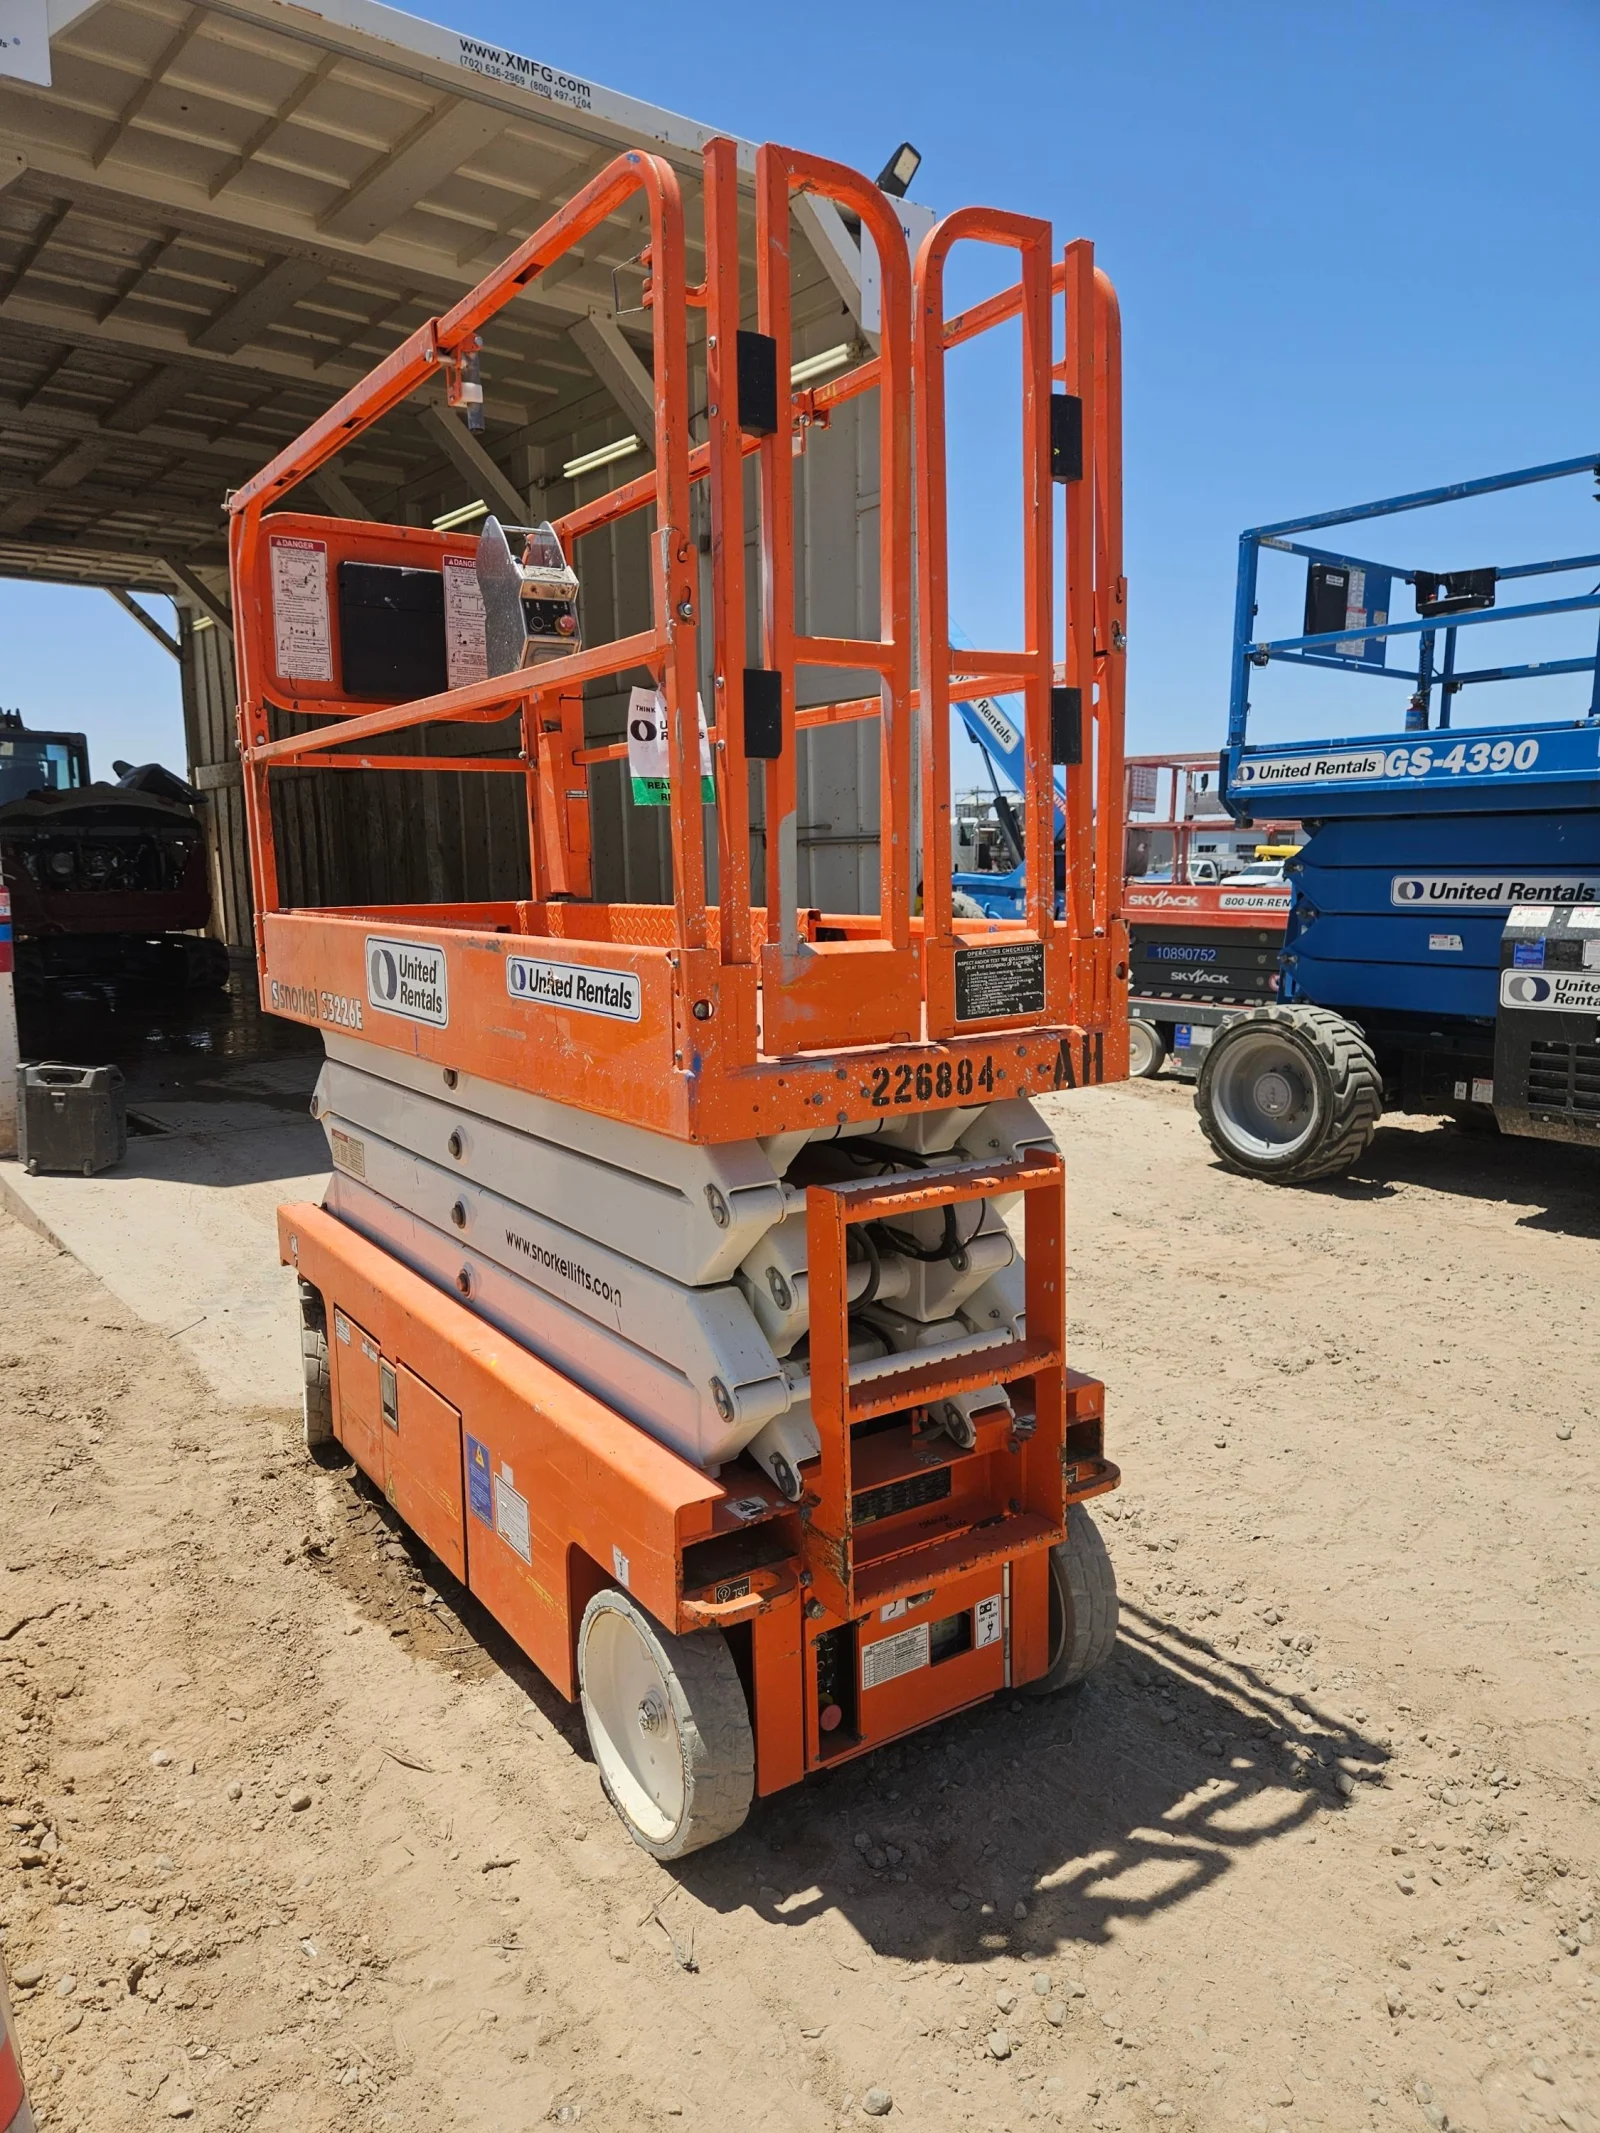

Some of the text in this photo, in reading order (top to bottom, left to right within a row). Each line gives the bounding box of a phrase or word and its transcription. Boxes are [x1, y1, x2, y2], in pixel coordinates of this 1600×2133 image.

[460, 39, 591, 97] www.XMFG.com
[460, 55, 483, 71] (702)
[486, 64, 525, 86] 636-2969
[530, 79, 552, 97] (800)
[282, 539, 314, 550] DANGER
[636, 704, 656, 713] THINK
[977, 699, 1012, 744] Rentals
[1258, 758, 1376, 780] United Rentals
[1384, 740, 1539, 778] GS-4390
[1128, 890, 1199, 908] SKYJACK
[1430, 882, 1596, 901] United Rentals
[400, 954, 437, 984] United
[1156, 946, 1217, 962] 10890752
[528, 968, 632, 1010] United Rentals
[1170, 968, 1230, 984] SKYJACK
[320, 990, 363, 1031] S3226E
[400, 980, 443, 1014] Rentals
[872, 1055, 994, 1107] 226884
